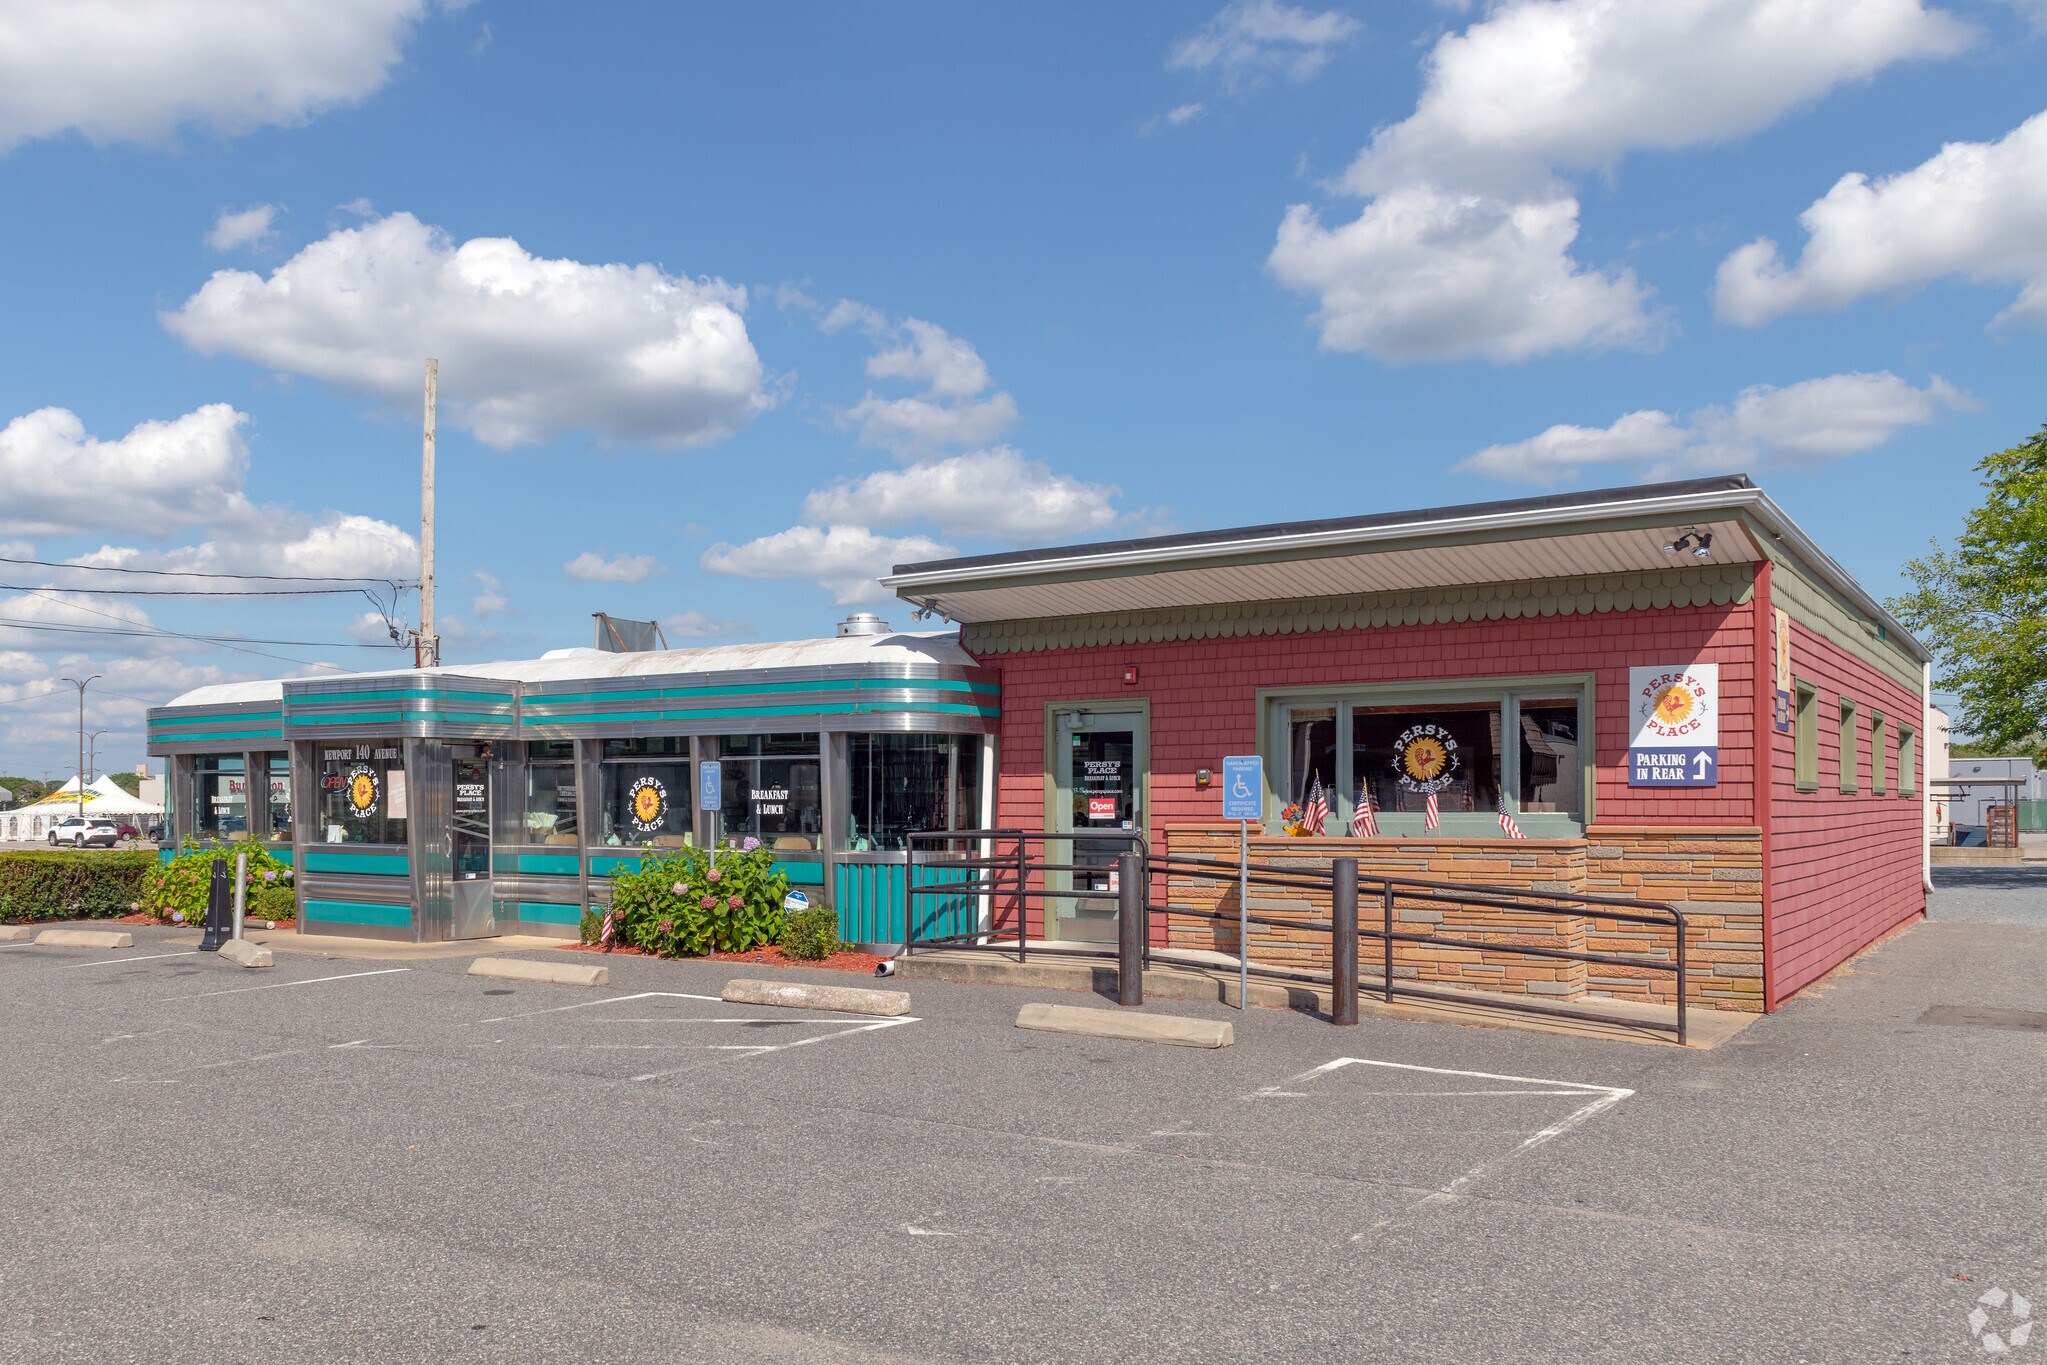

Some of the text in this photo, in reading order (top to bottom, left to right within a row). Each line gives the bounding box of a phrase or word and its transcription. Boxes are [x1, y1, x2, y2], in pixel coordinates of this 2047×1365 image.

[1642, 673, 1706, 698] PERSY'S
[1646, 718, 1701, 737] PLACE
[1393, 724, 1459, 752] PERSY'S
[324, 744, 397, 761] NEWPORT 140 AVENUE
[1636, 753, 1686, 766] PARKING
[347, 765, 379, 786] PERSY'S
[1636, 767, 1685, 780] IN REAR
[323, 776, 347, 789] OPEN
[628, 777, 667, 798] PERSY'S
[1398, 772, 1454, 793] PLACE
[751, 789, 789, 800] BREAKFAST
[349, 802, 377, 818] PLACE
[755, 803, 784, 815] & LUNCH
[1090, 801, 1114, 813] Open
[631, 816, 665, 831] PLACE
